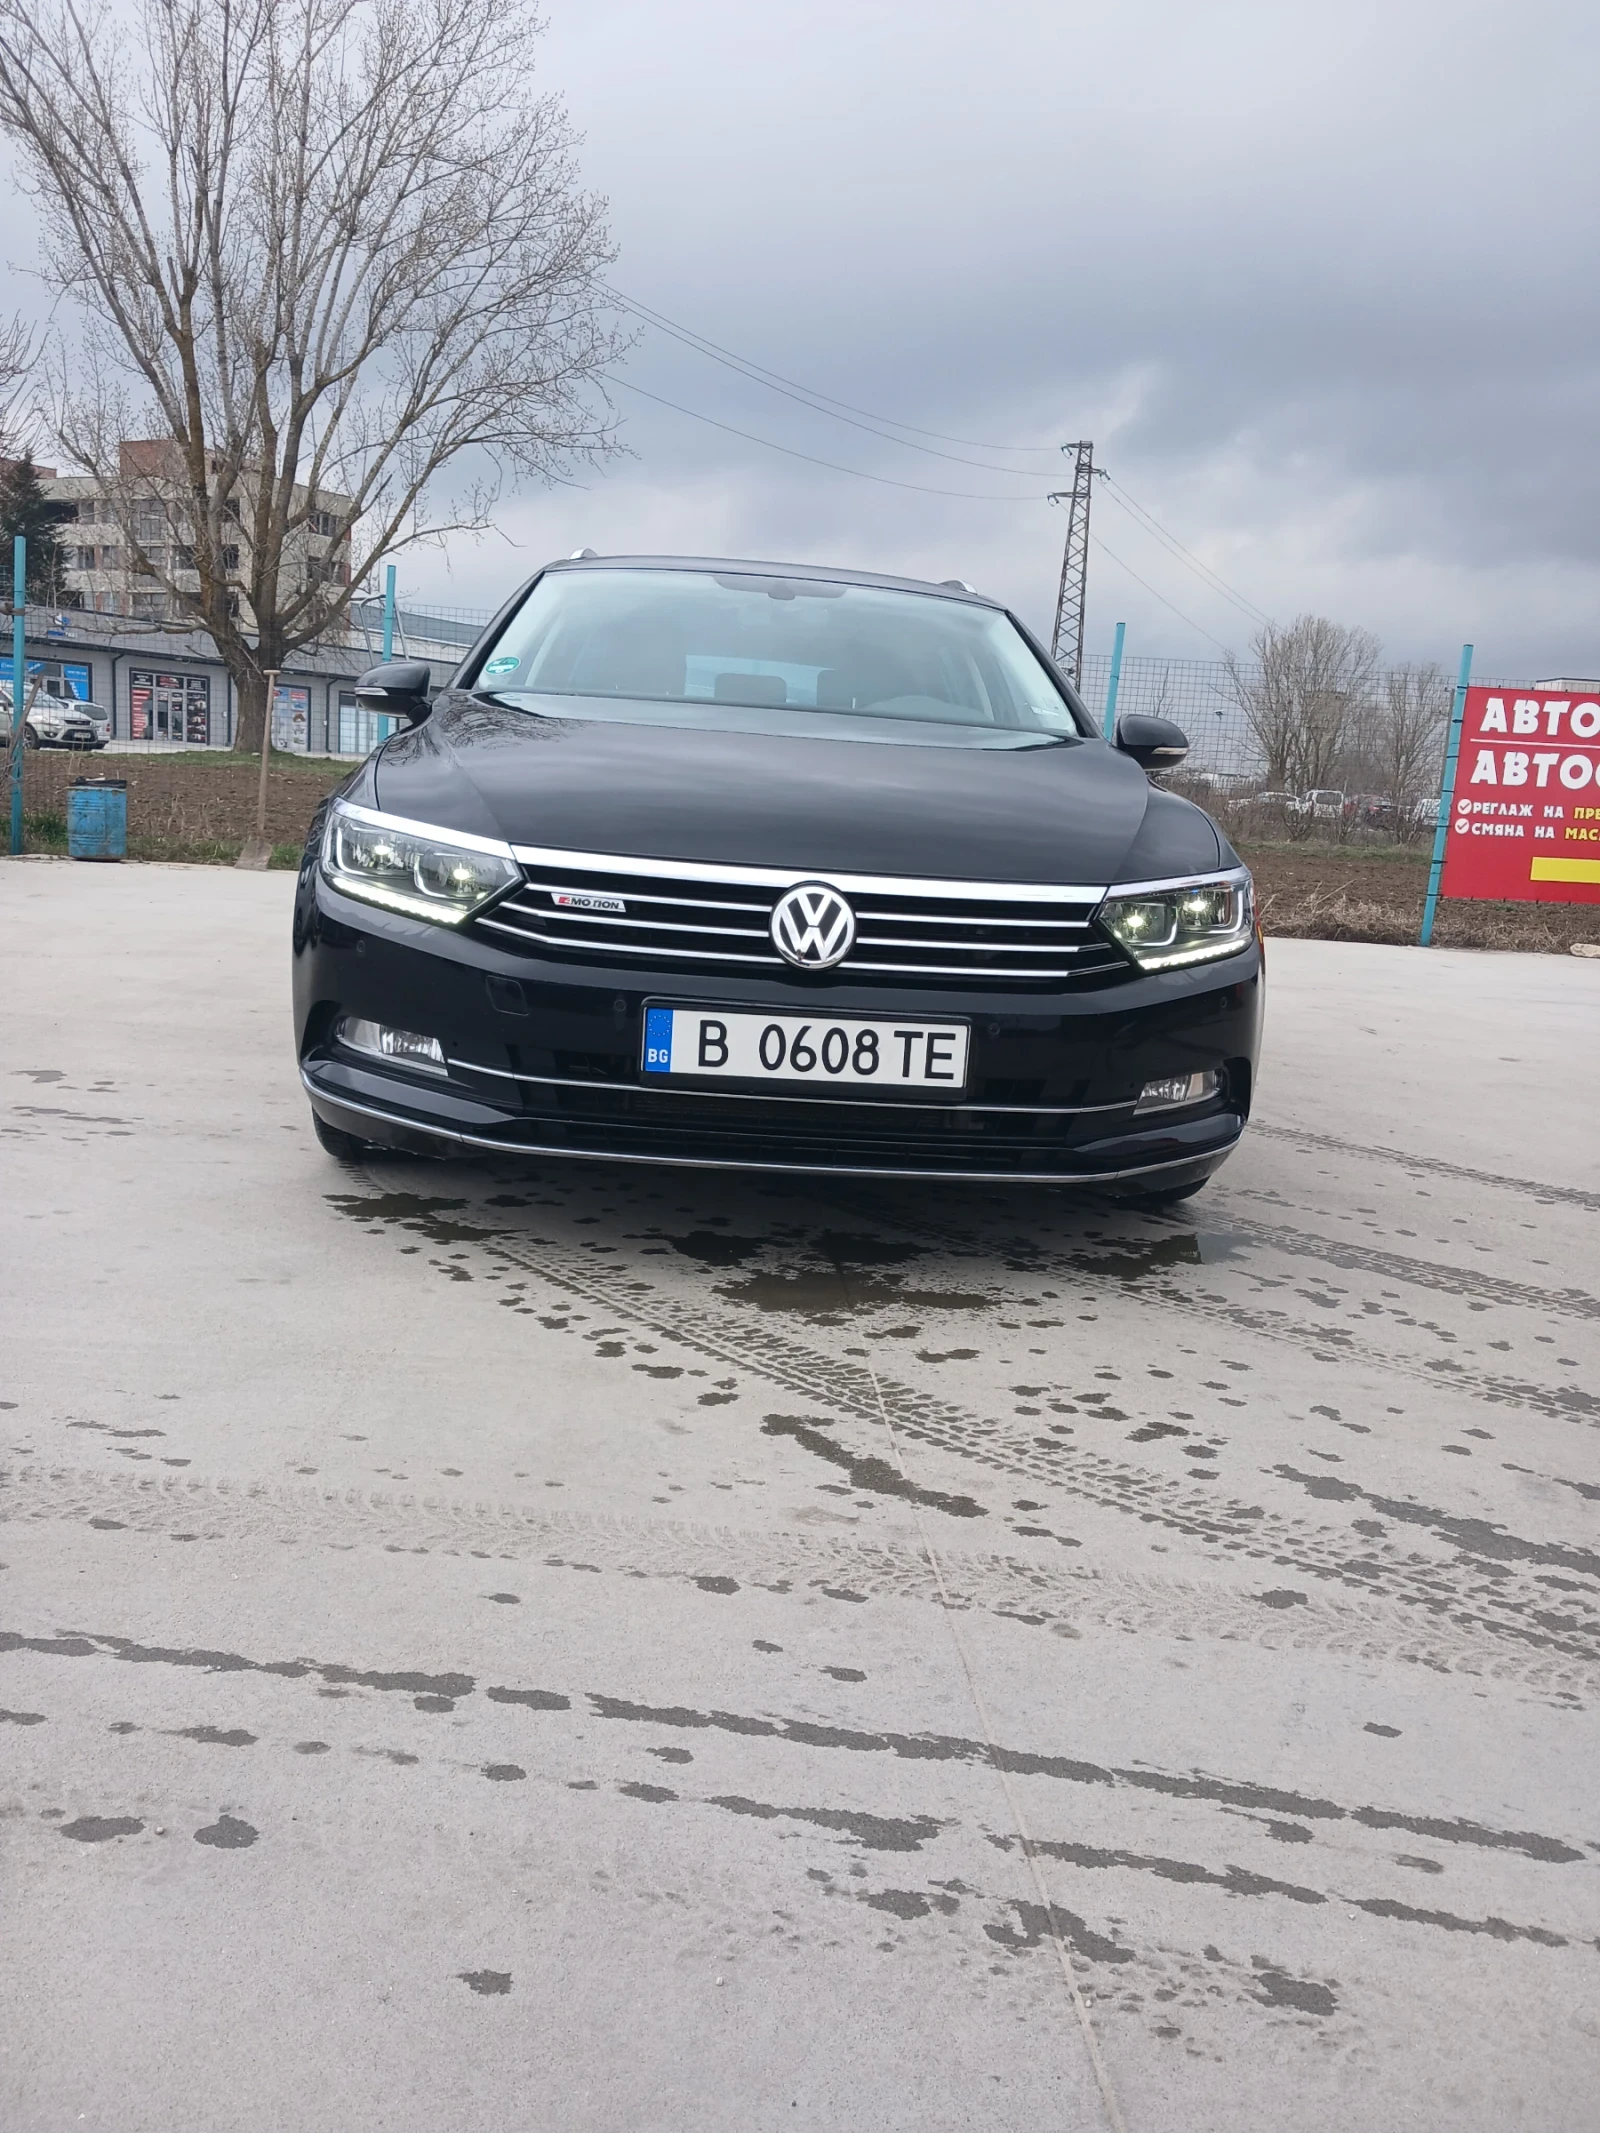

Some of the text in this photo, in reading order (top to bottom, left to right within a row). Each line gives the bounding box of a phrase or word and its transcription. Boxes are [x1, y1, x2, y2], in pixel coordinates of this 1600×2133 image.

[1470, 749, 1600, 789] АВТО
[1472, 802, 1534, 817] РЕГЛАЖ
[1543, 805, 1564, 818] НА
[1471, 822, 1600, 841] СМЯНА НА МАС
[648, 1048, 669, 1064] BG
[698, 1019, 957, 1080] B 0608 TE
